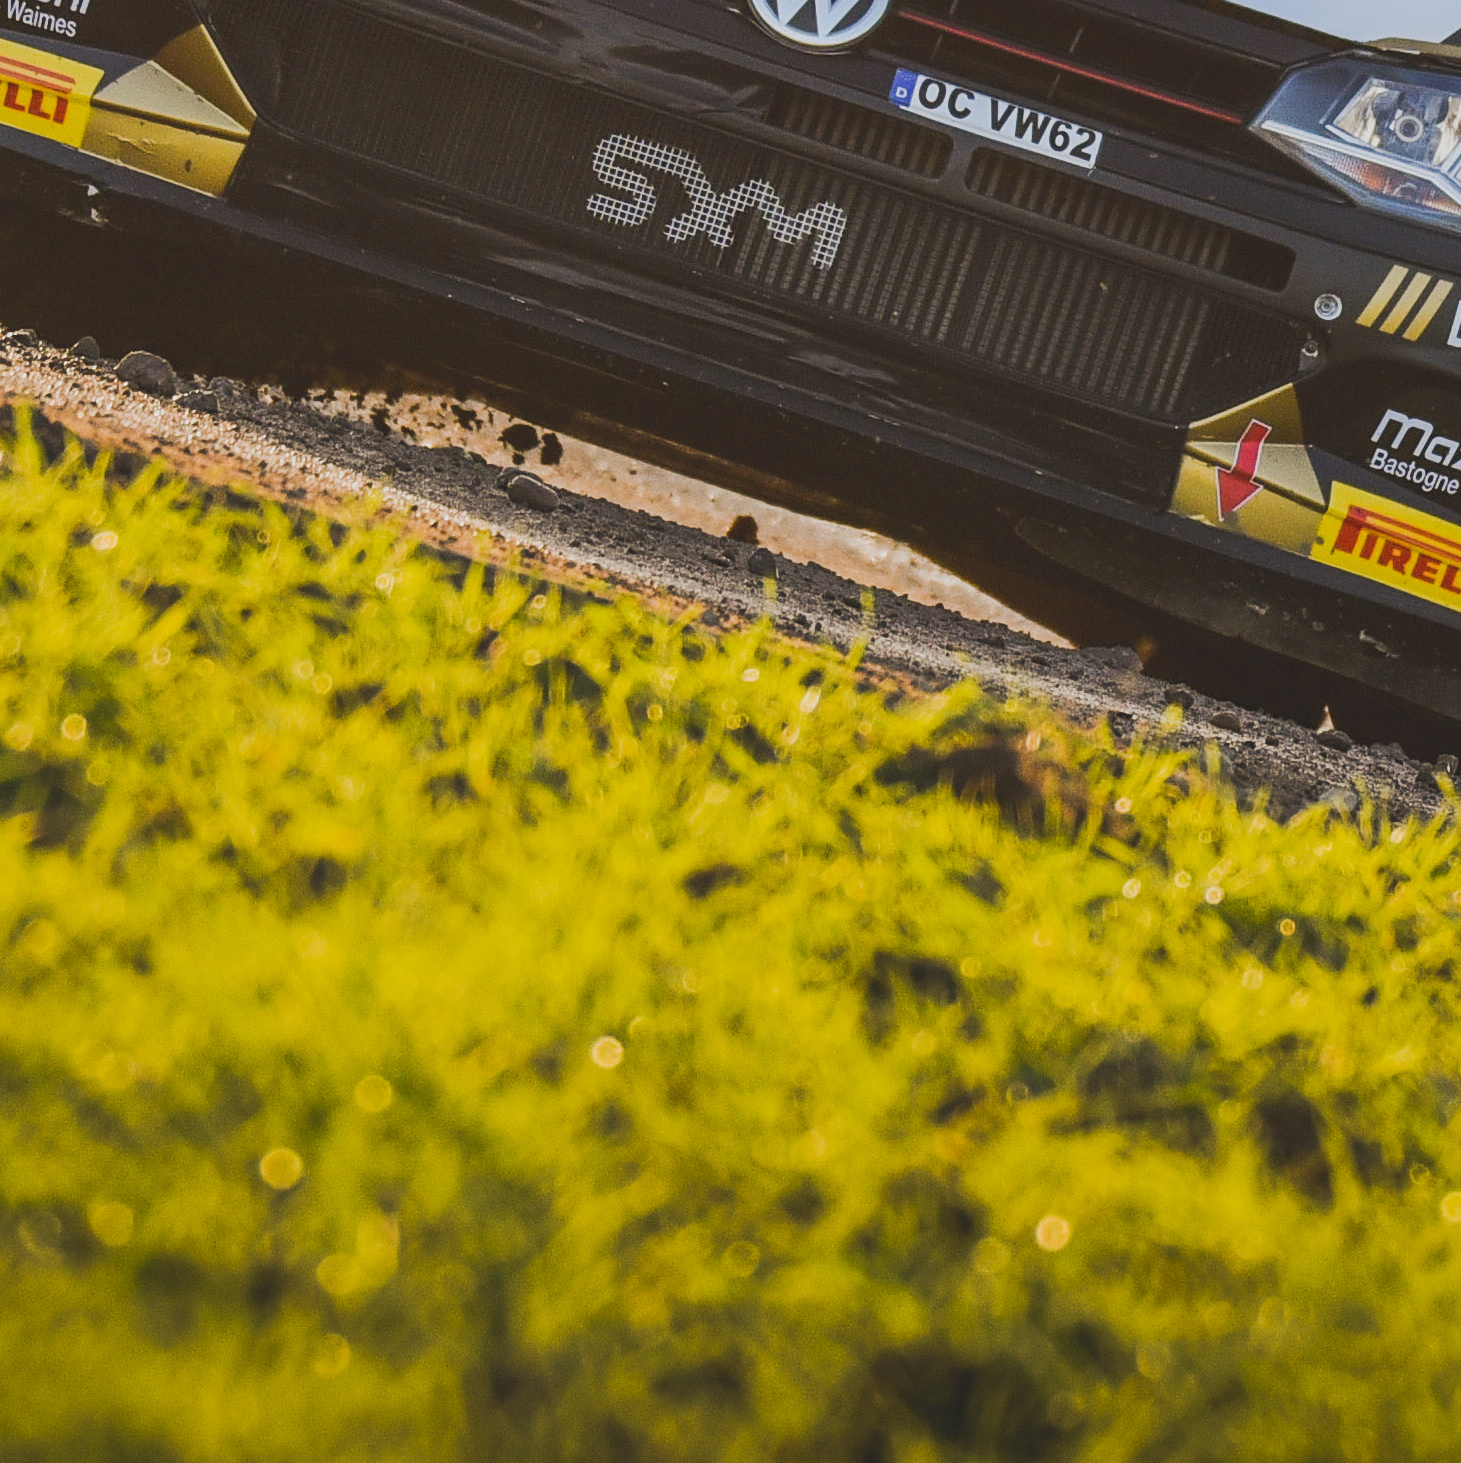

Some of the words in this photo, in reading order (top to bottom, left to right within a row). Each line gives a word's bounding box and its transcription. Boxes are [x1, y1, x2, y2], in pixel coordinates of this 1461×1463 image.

[918, 77, 975, 120] OC
[990, 97, 1097, 162] VW62
[1369, 447, 1460, 495] Bastogne
